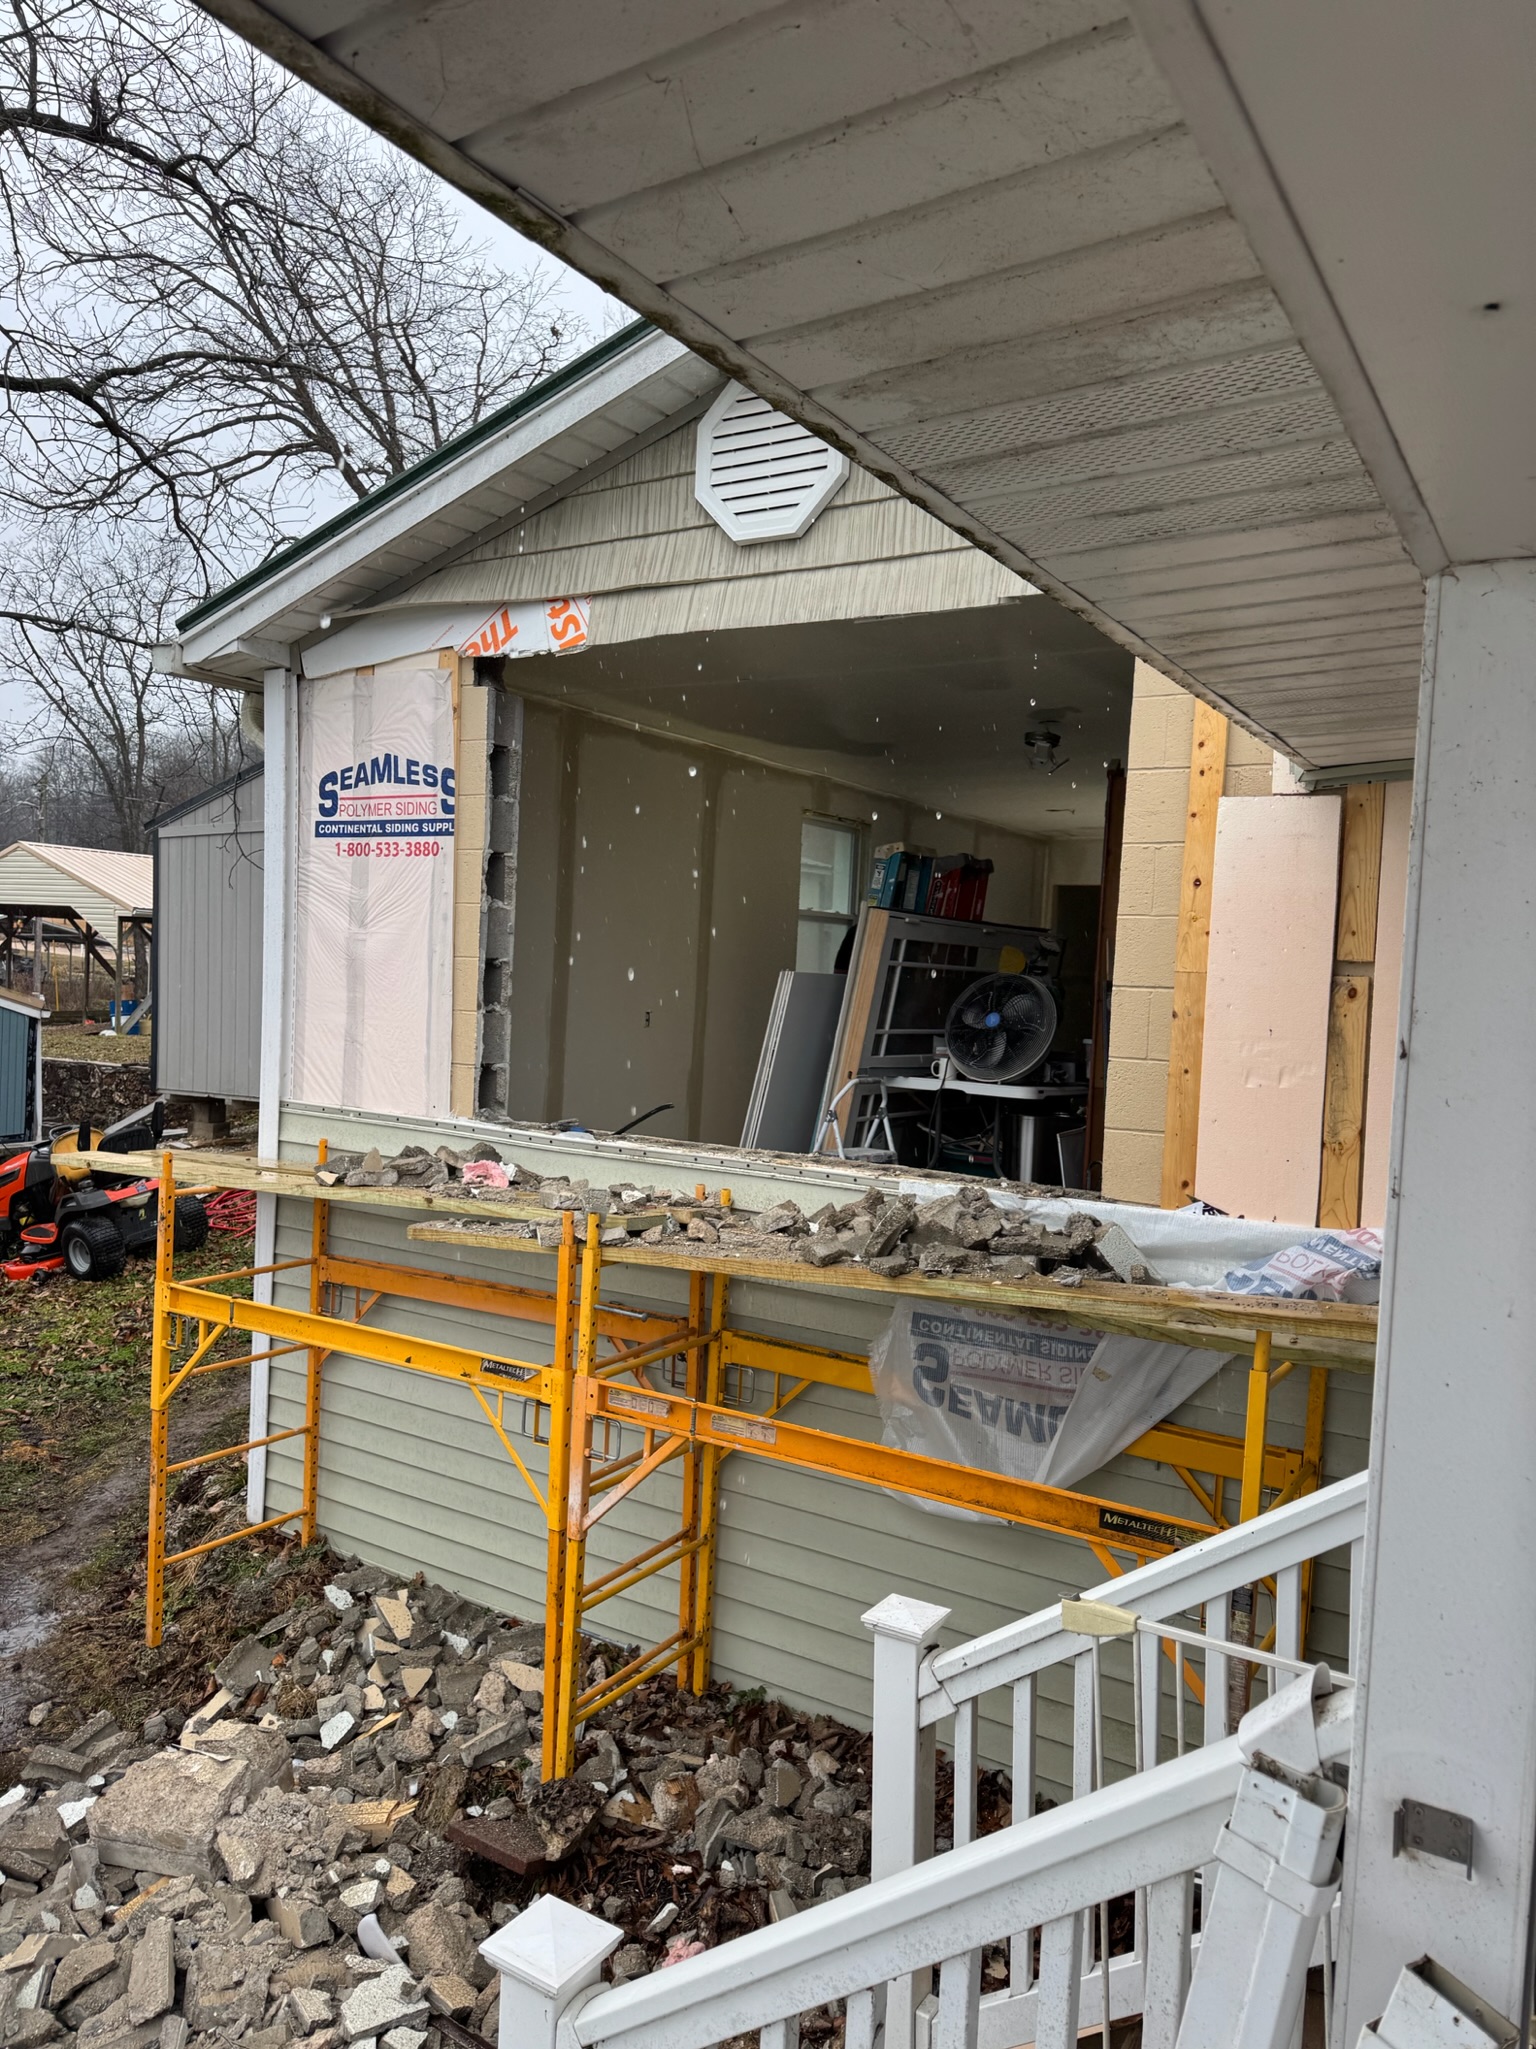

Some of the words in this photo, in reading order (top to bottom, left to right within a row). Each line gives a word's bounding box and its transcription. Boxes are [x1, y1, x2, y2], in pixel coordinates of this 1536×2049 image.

[318, 753, 455, 817] SEAMLESS
[339, 802, 392, 817] POLYMER
[395, 800, 438, 816] SIDING
[318, 824, 383, 834] CONTINENTAL
[385, 822, 419, 832] SIDING
[335, 841, 440, 857] 1-800-533-3880
